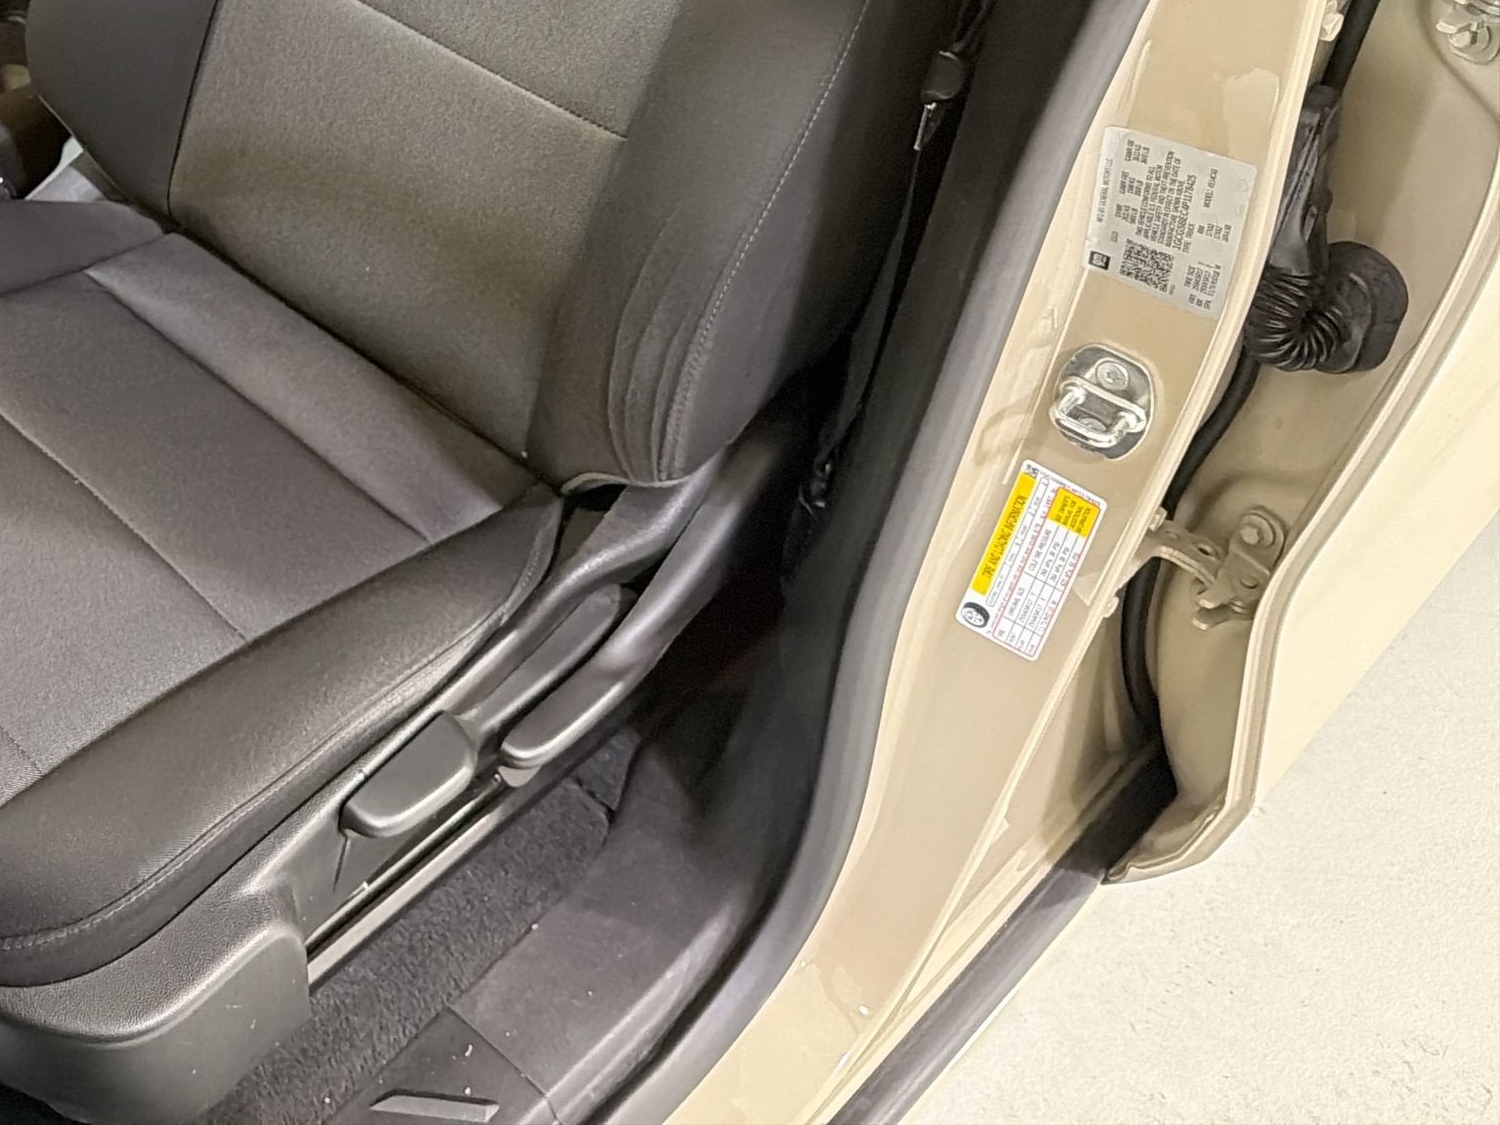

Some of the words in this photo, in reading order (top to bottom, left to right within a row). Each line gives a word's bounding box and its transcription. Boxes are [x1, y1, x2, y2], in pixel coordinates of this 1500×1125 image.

[1147, 165, 1155, 175] ALL
[1162, 150, 1175, 180] PREVENTION
[1174, 157, 1181, 165] OF
[1146, 174, 1153, 182] TO
[1154, 163, 1163, 182] MOTOR
[1171, 165, 1180, 178] DATE
[1150, 181, 1160, 202] FEDERAL
[1159, 180, 1168, 195] THEFT
[1168, 187, 1175, 195] ON
[1169, 178, 1177, 187] THE
[1141, 181, 1152, 207] CONFORMS
[1158, 195, 1166, 205] AND
[1164, 195, 1174, 212] EFFECT
[1137, 207, 1147, 226] VEHICLE
[1154, 205, 1163, 223] SAFETY
[1164, 214, 1178, 247] MANUFACTURE
[1172, 196, 1182, 214] SHOWN
[1142, 212, 1154, 239] APPLICABLE
[1150, 223, 1159, 242] VEHICLE
[1157, 217, 1169, 244] STANDARDS
[1186, 223, 1195, 239] TRUCK
[1004, 493, 1027, 531] INFORMATION
[1061, 509, 1073, 526] MANUAL
[1069, 499, 1077, 509] FOR
[1070, 505, 1084, 529] ADDITIONAL
[1076, 507, 1091, 534] INFORMATION
[993, 528, 1011, 556] LOADING
[1028, 558, 1038, 572] COLD
[1034, 549, 1042, 560] TIRE
[1038, 528, 1052, 551] PRESSURE
[988, 553, 1000, 566] AND
[982, 564, 995, 580] TIRE
